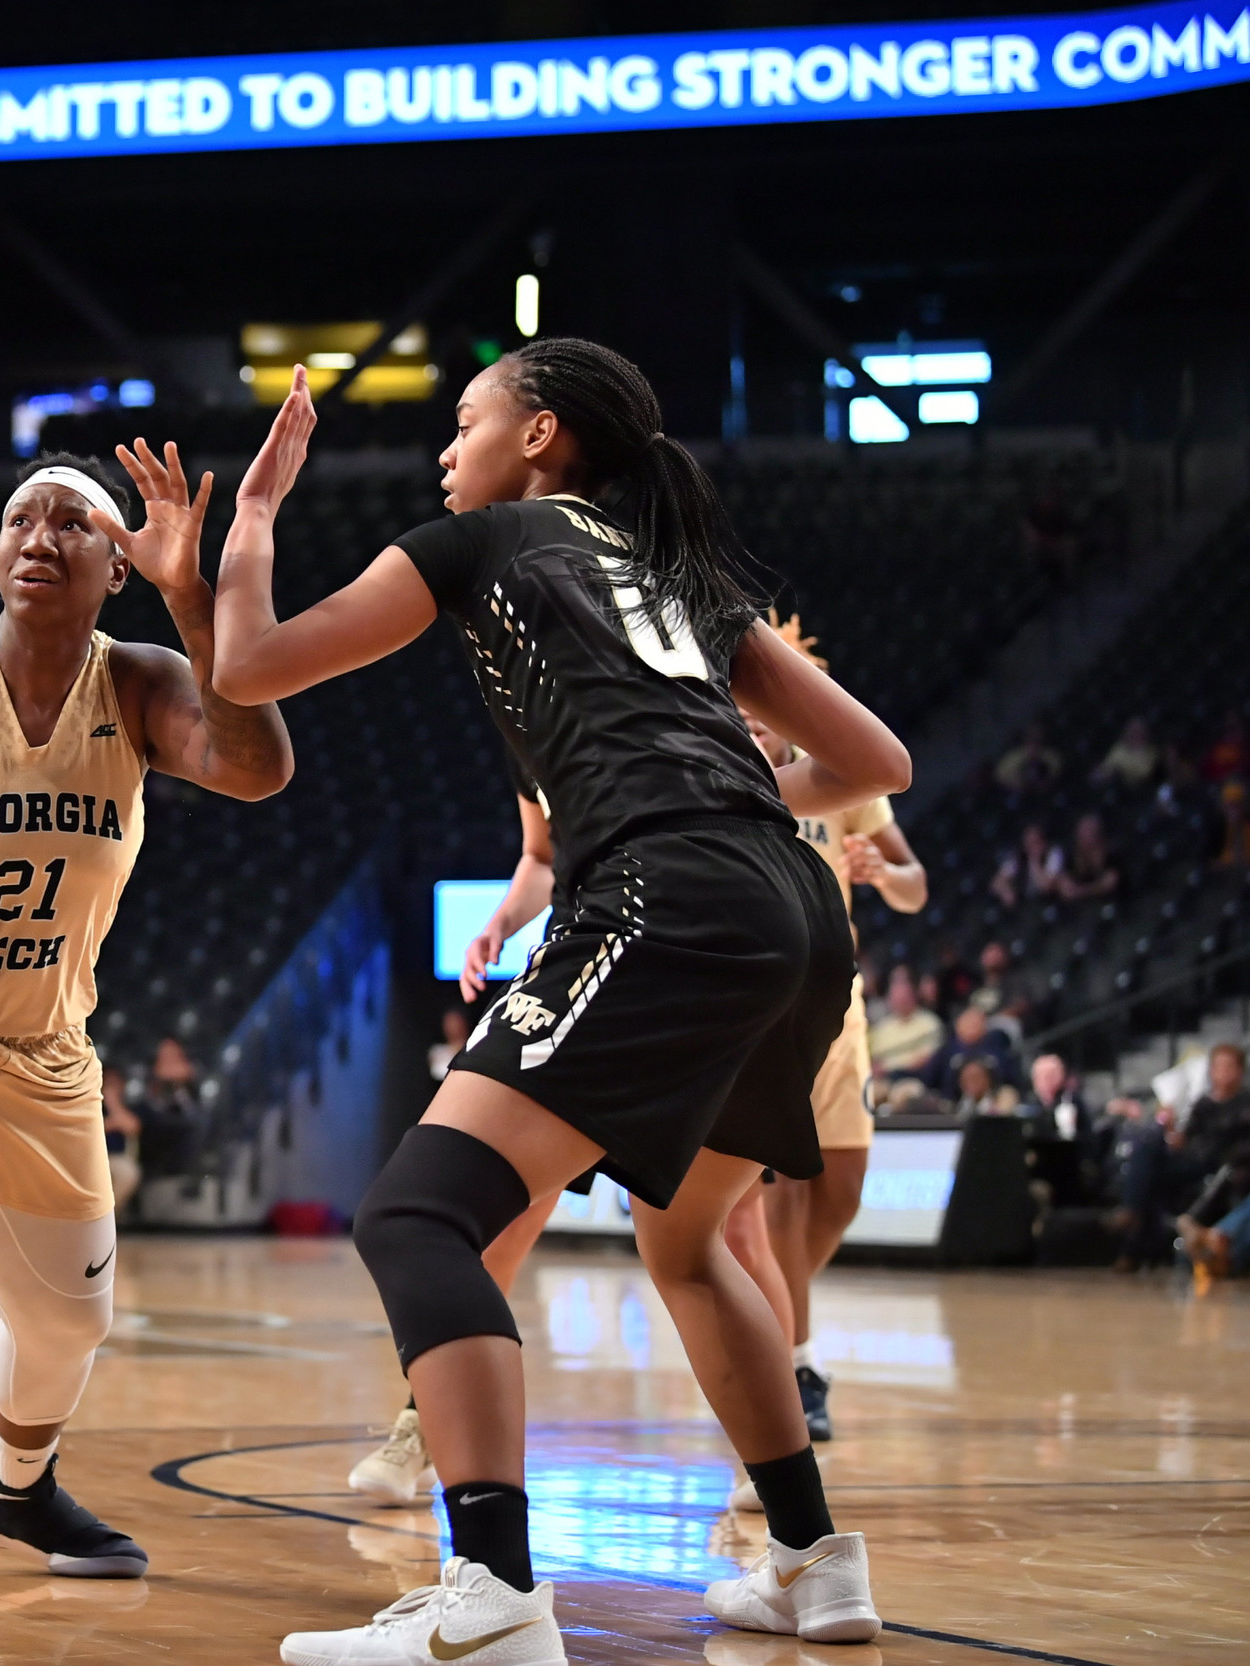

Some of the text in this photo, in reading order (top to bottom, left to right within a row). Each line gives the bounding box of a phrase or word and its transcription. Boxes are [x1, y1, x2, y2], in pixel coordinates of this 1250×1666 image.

[239, 72, 333, 132] TO
[343, 54, 662, 126] BUILDING
[671, 33, 1040, 110] STRONGER
[500, 991, 557, 1036] WF
